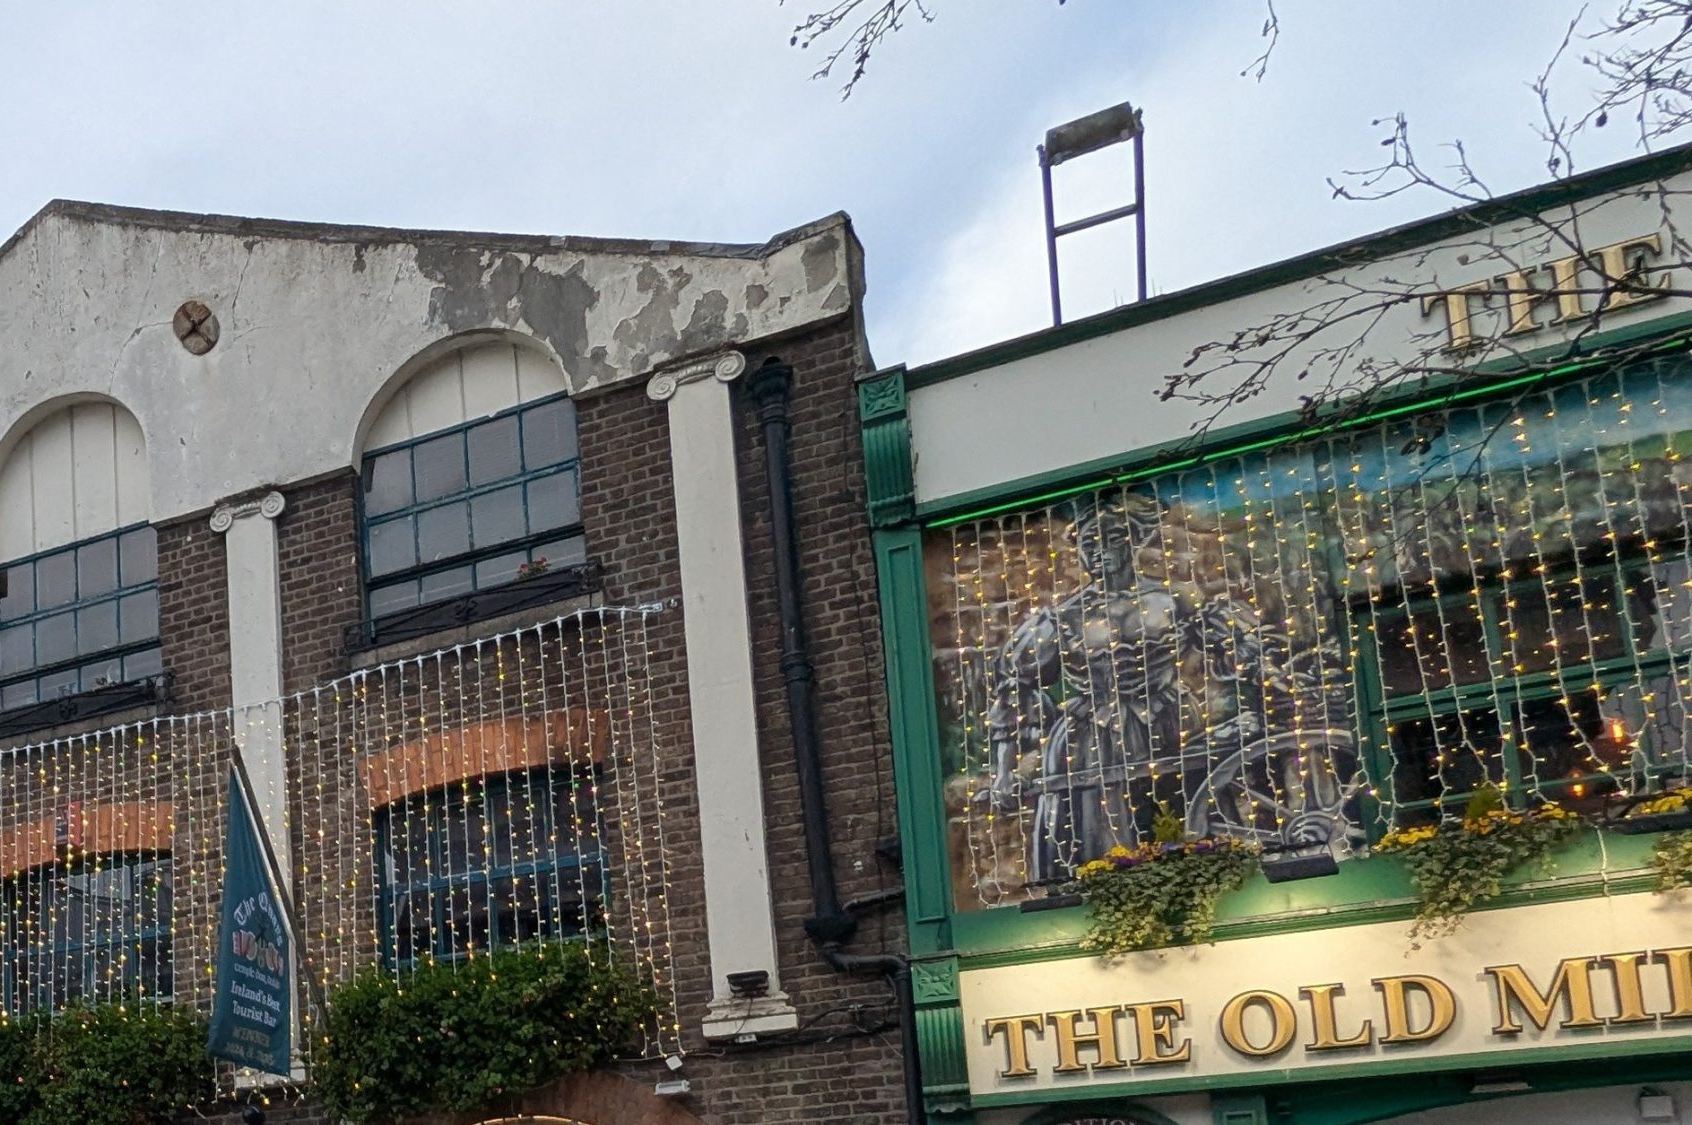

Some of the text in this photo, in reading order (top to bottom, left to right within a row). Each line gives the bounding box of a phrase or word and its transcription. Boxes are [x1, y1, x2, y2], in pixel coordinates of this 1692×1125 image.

[1420, 232, 1671, 351] THE
[232, 1000, 277, 1028] Tourist Bar
[986, 999, 1192, 1078] THE
[1219, 974, 1457, 1060] OLD
